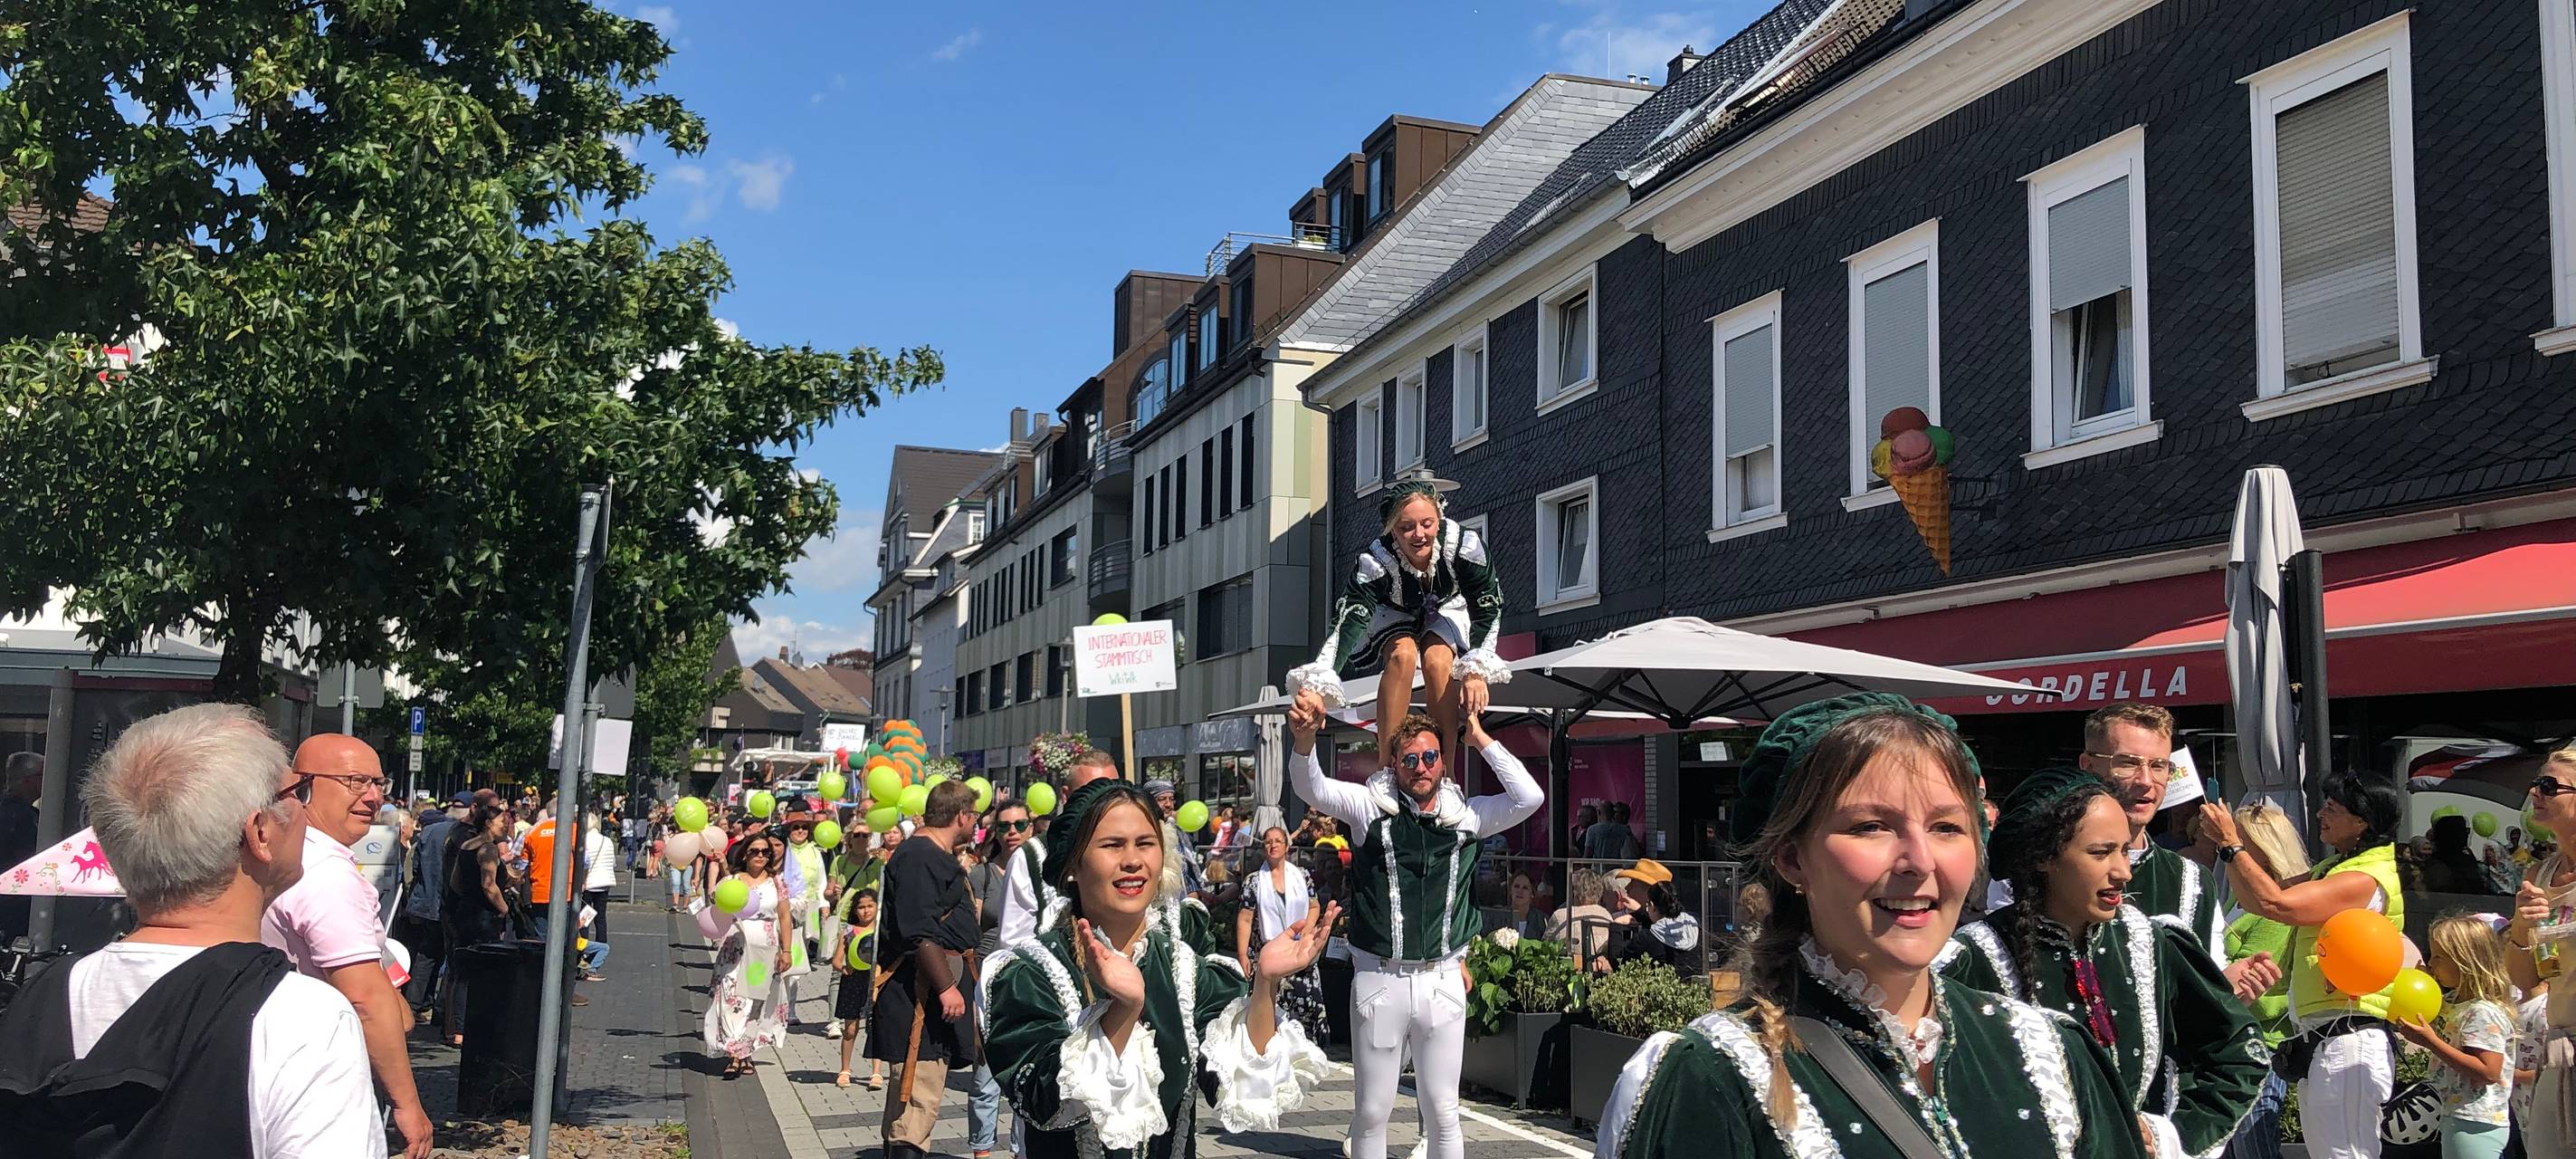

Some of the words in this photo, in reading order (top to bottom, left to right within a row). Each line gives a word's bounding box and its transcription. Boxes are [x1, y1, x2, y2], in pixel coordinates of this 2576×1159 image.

[1088, 629, 1167, 650] INTERNATIONALER
[1094, 649, 1152, 668] STAMMTISCH
[414, 711, 422, 732] P
